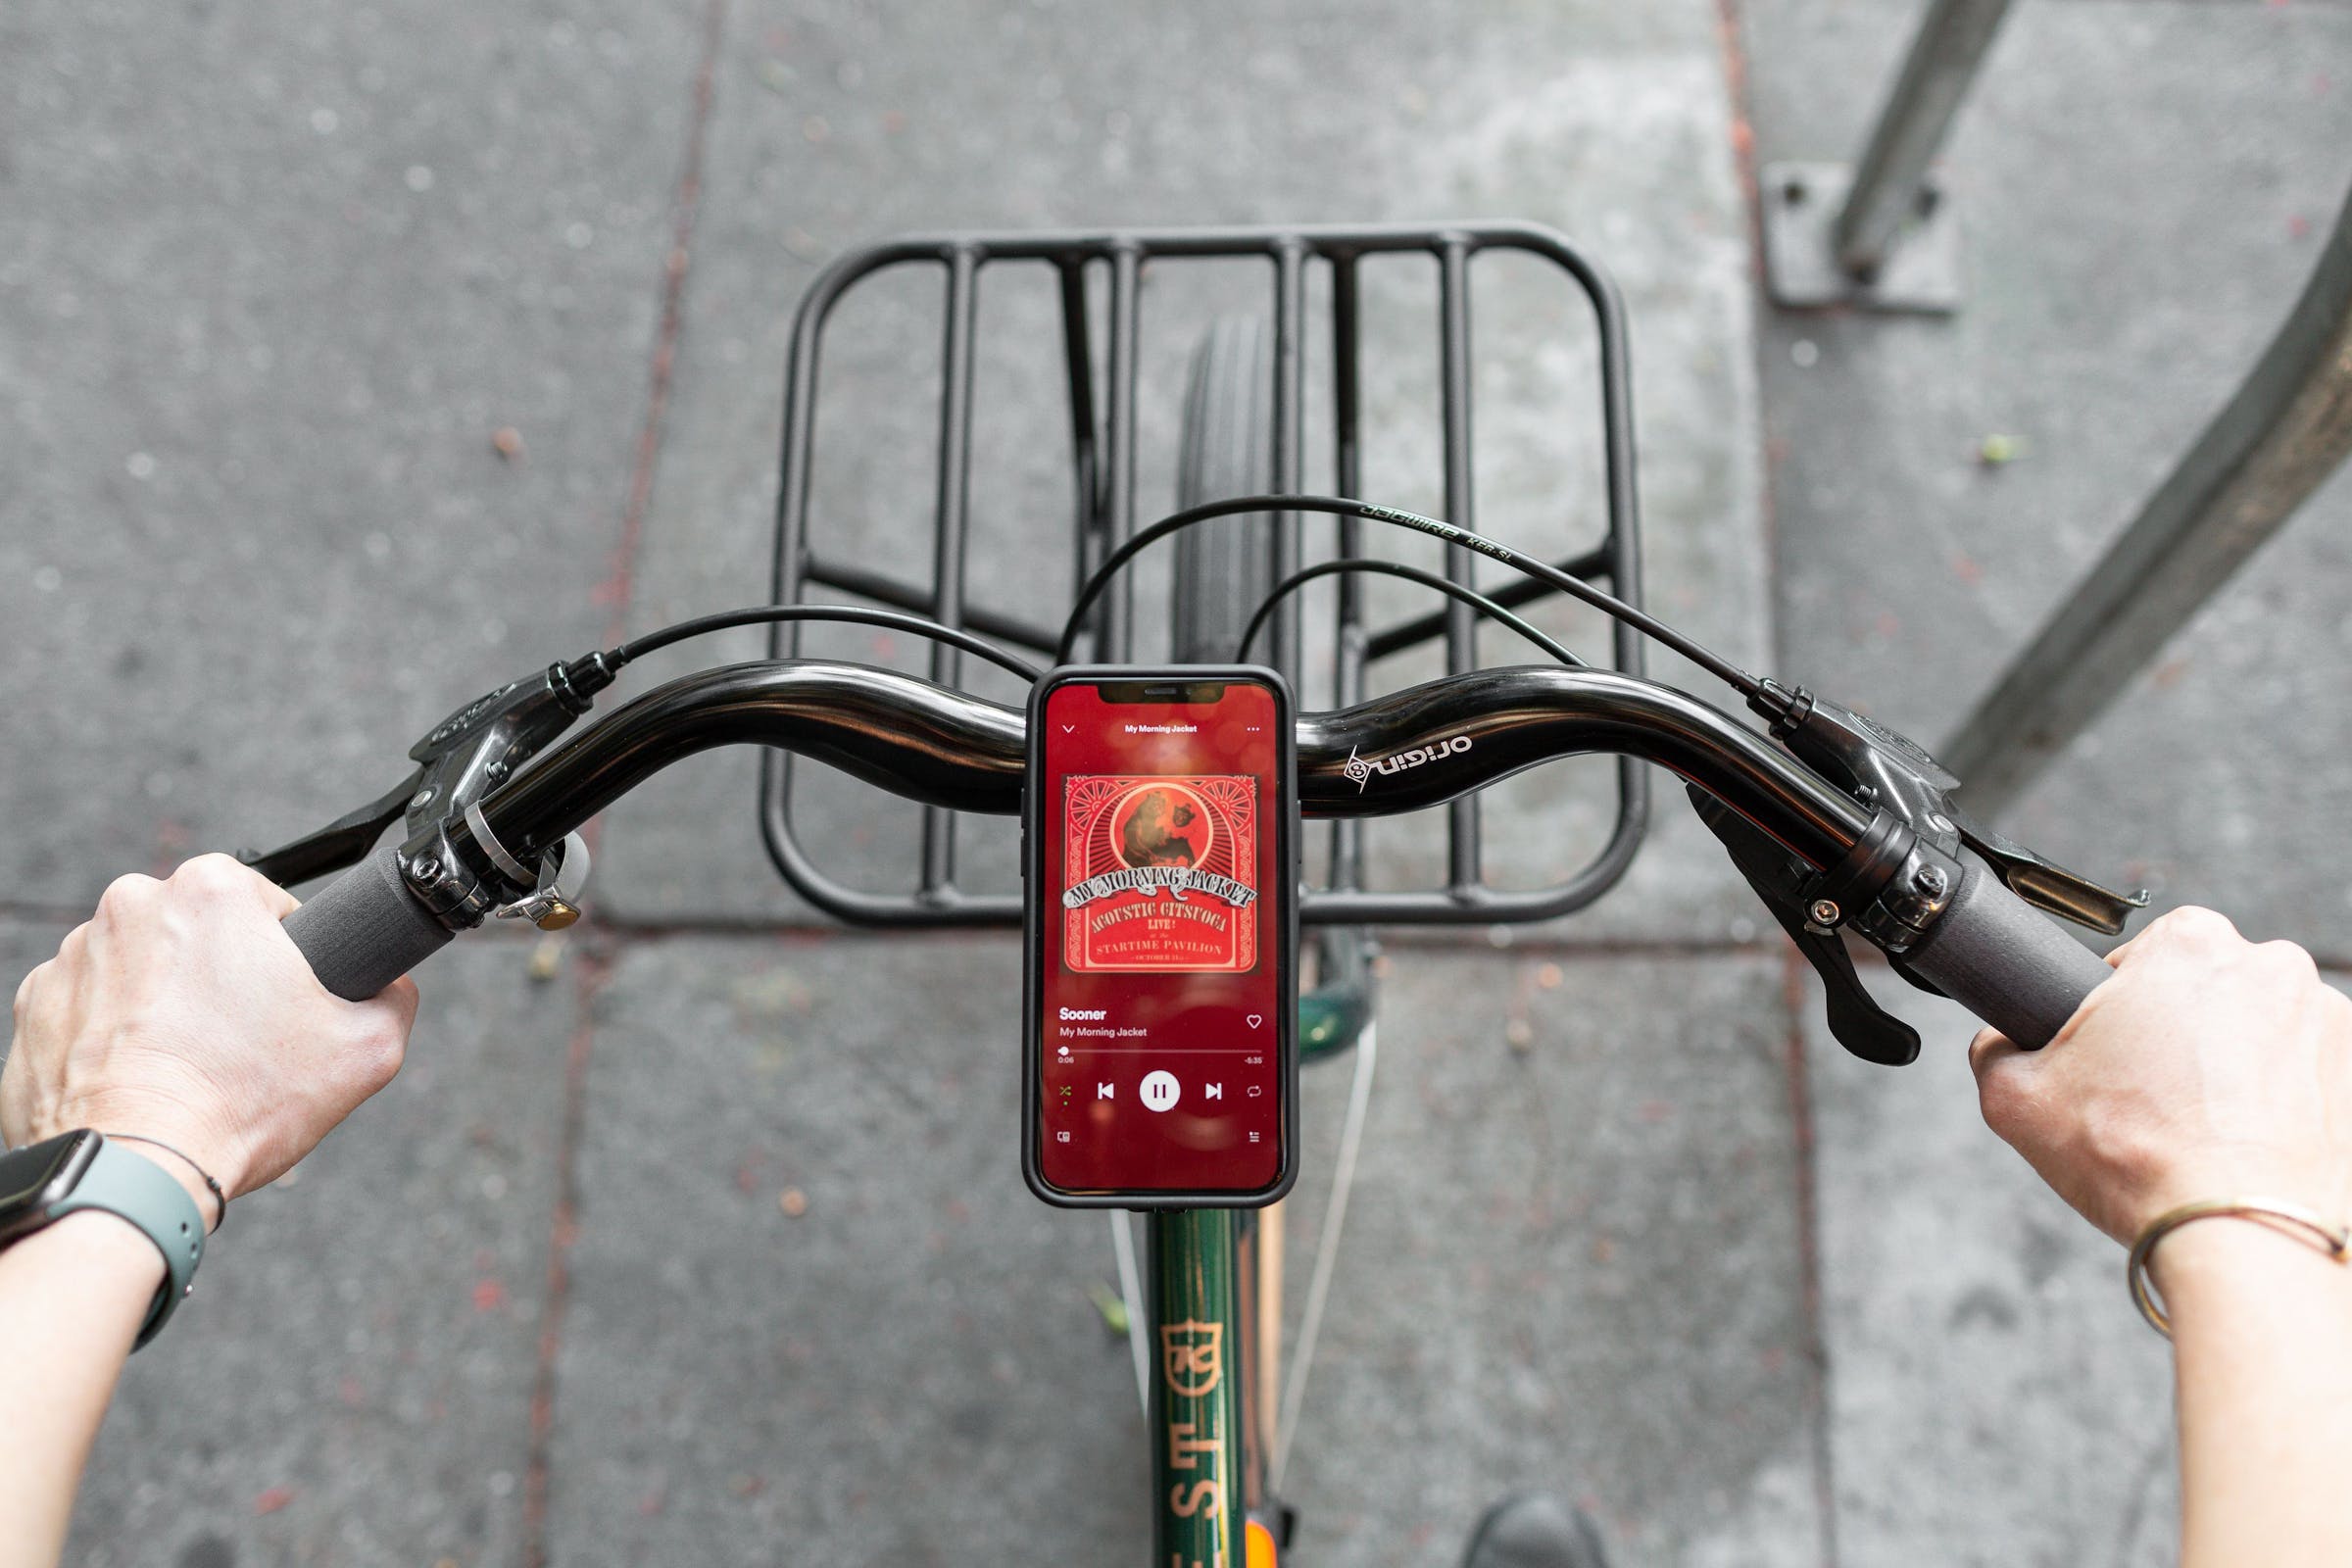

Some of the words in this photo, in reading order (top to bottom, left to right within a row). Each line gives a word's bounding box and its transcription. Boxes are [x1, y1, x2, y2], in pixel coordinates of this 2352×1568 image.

[1124, 724, 1138, 734] My
[1138, 724, 1171, 734] Morning
[1171, 724, 1198, 733] Jacket
[1070, 880, 1095, 906] MY
[1101, 866, 1180, 895] MORNING
[1186, 868, 1257, 907] JACKET
[1091, 902, 1156, 933] ACOUSTIC
[1097, 940, 1160, 956] STARTIME
[1163, 940, 1223, 956] PAVILION
[1059, 1006, 1107, 1020] Sooner
[1059, 1027, 1075, 1038] My
[1077, 1027, 1115, 1038] Morning
[1116, 1027, 1148, 1037] Jacket
